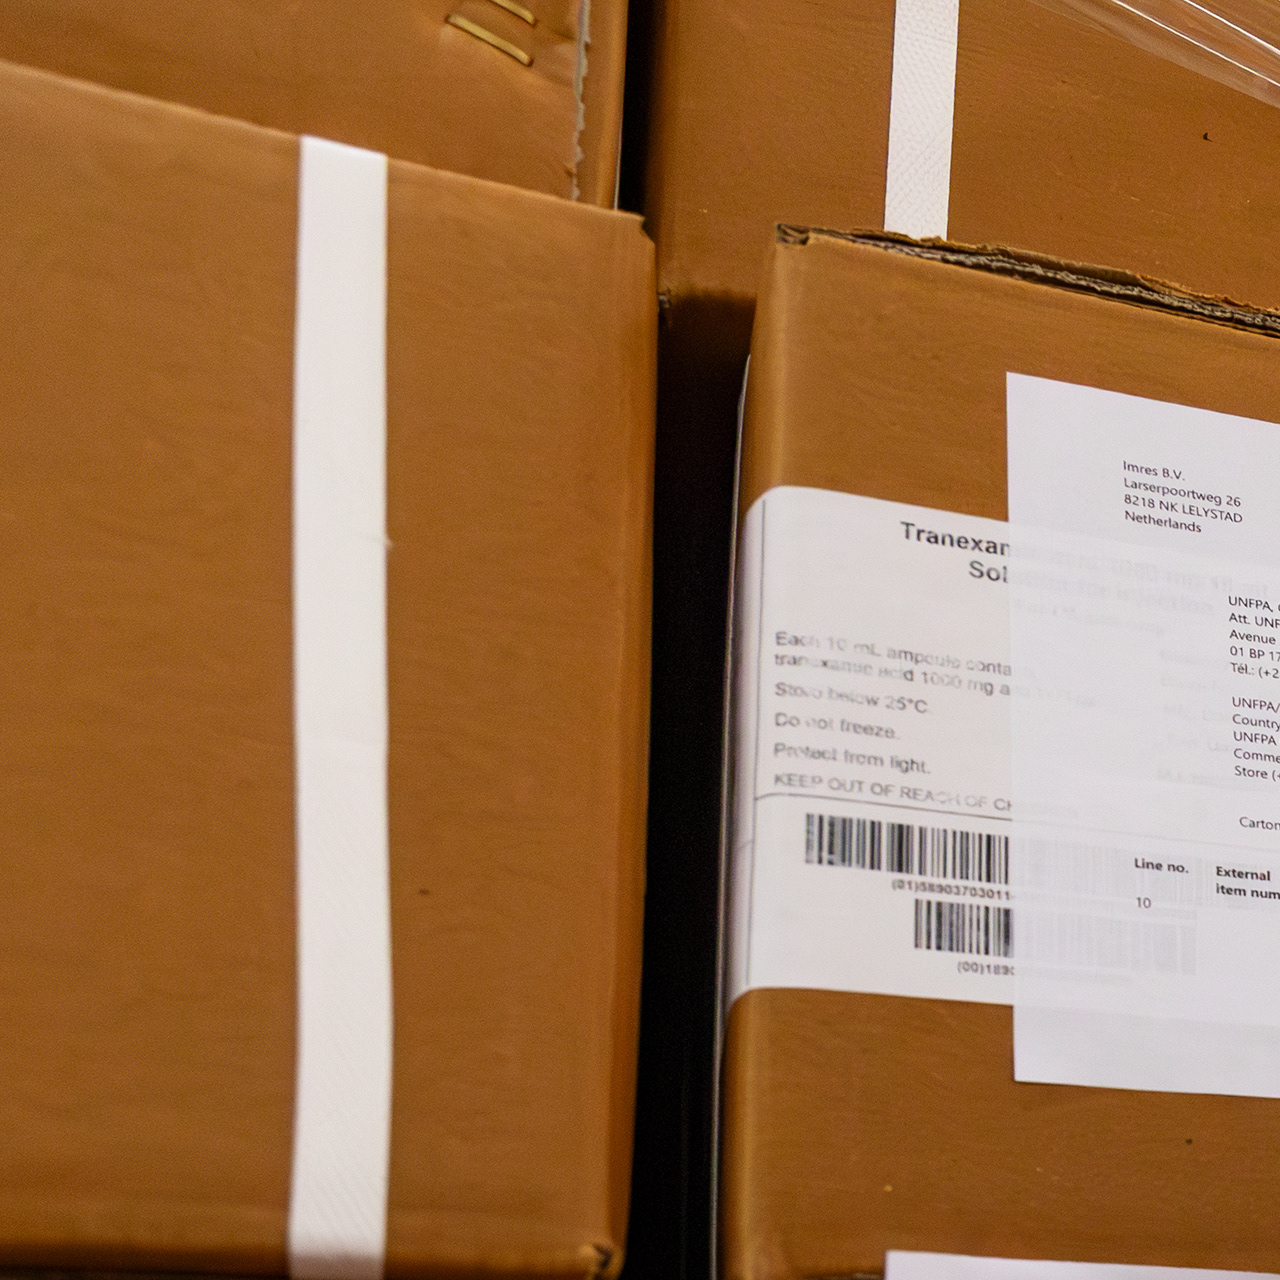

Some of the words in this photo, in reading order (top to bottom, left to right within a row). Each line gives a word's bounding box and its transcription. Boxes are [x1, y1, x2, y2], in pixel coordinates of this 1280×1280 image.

[1123, 461, 1158, 476] Imres
[1162, 468, 1185, 481] B.V.
[1124, 478, 1222, 506] Larserpoortweg
[1226, 495, 1241, 507] 26
[1124, 494, 1155, 508] 8218
[1159, 500, 1178, 512] NK
[1182, 504, 1242, 523] LELYSTAD
[1125, 510, 1201, 533] Netherlands
[900, 521, 1009, 556] Tranexa
[1229, 596, 1273, 612] UNFPA,
[1229, 613, 1250, 624] Att.
[1229, 629, 1276, 645] Avenue
[1234, 731, 1277, 746] UNFPA
[844, 750, 884, 767] from
[890, 756, 931, 774] light.
[774, 773, 823, 787] KEEP
[828, 778, 865, 792] OUT
[870, 782, 895, 797] OF
[1135, 858, 1163, 871] Line
[1167, 864, 1188, 873] no.
[1216, 866, 1270, 881] External
[1216, 883, 1246, 896] item
[1136, 897, 1151, 909] 10
